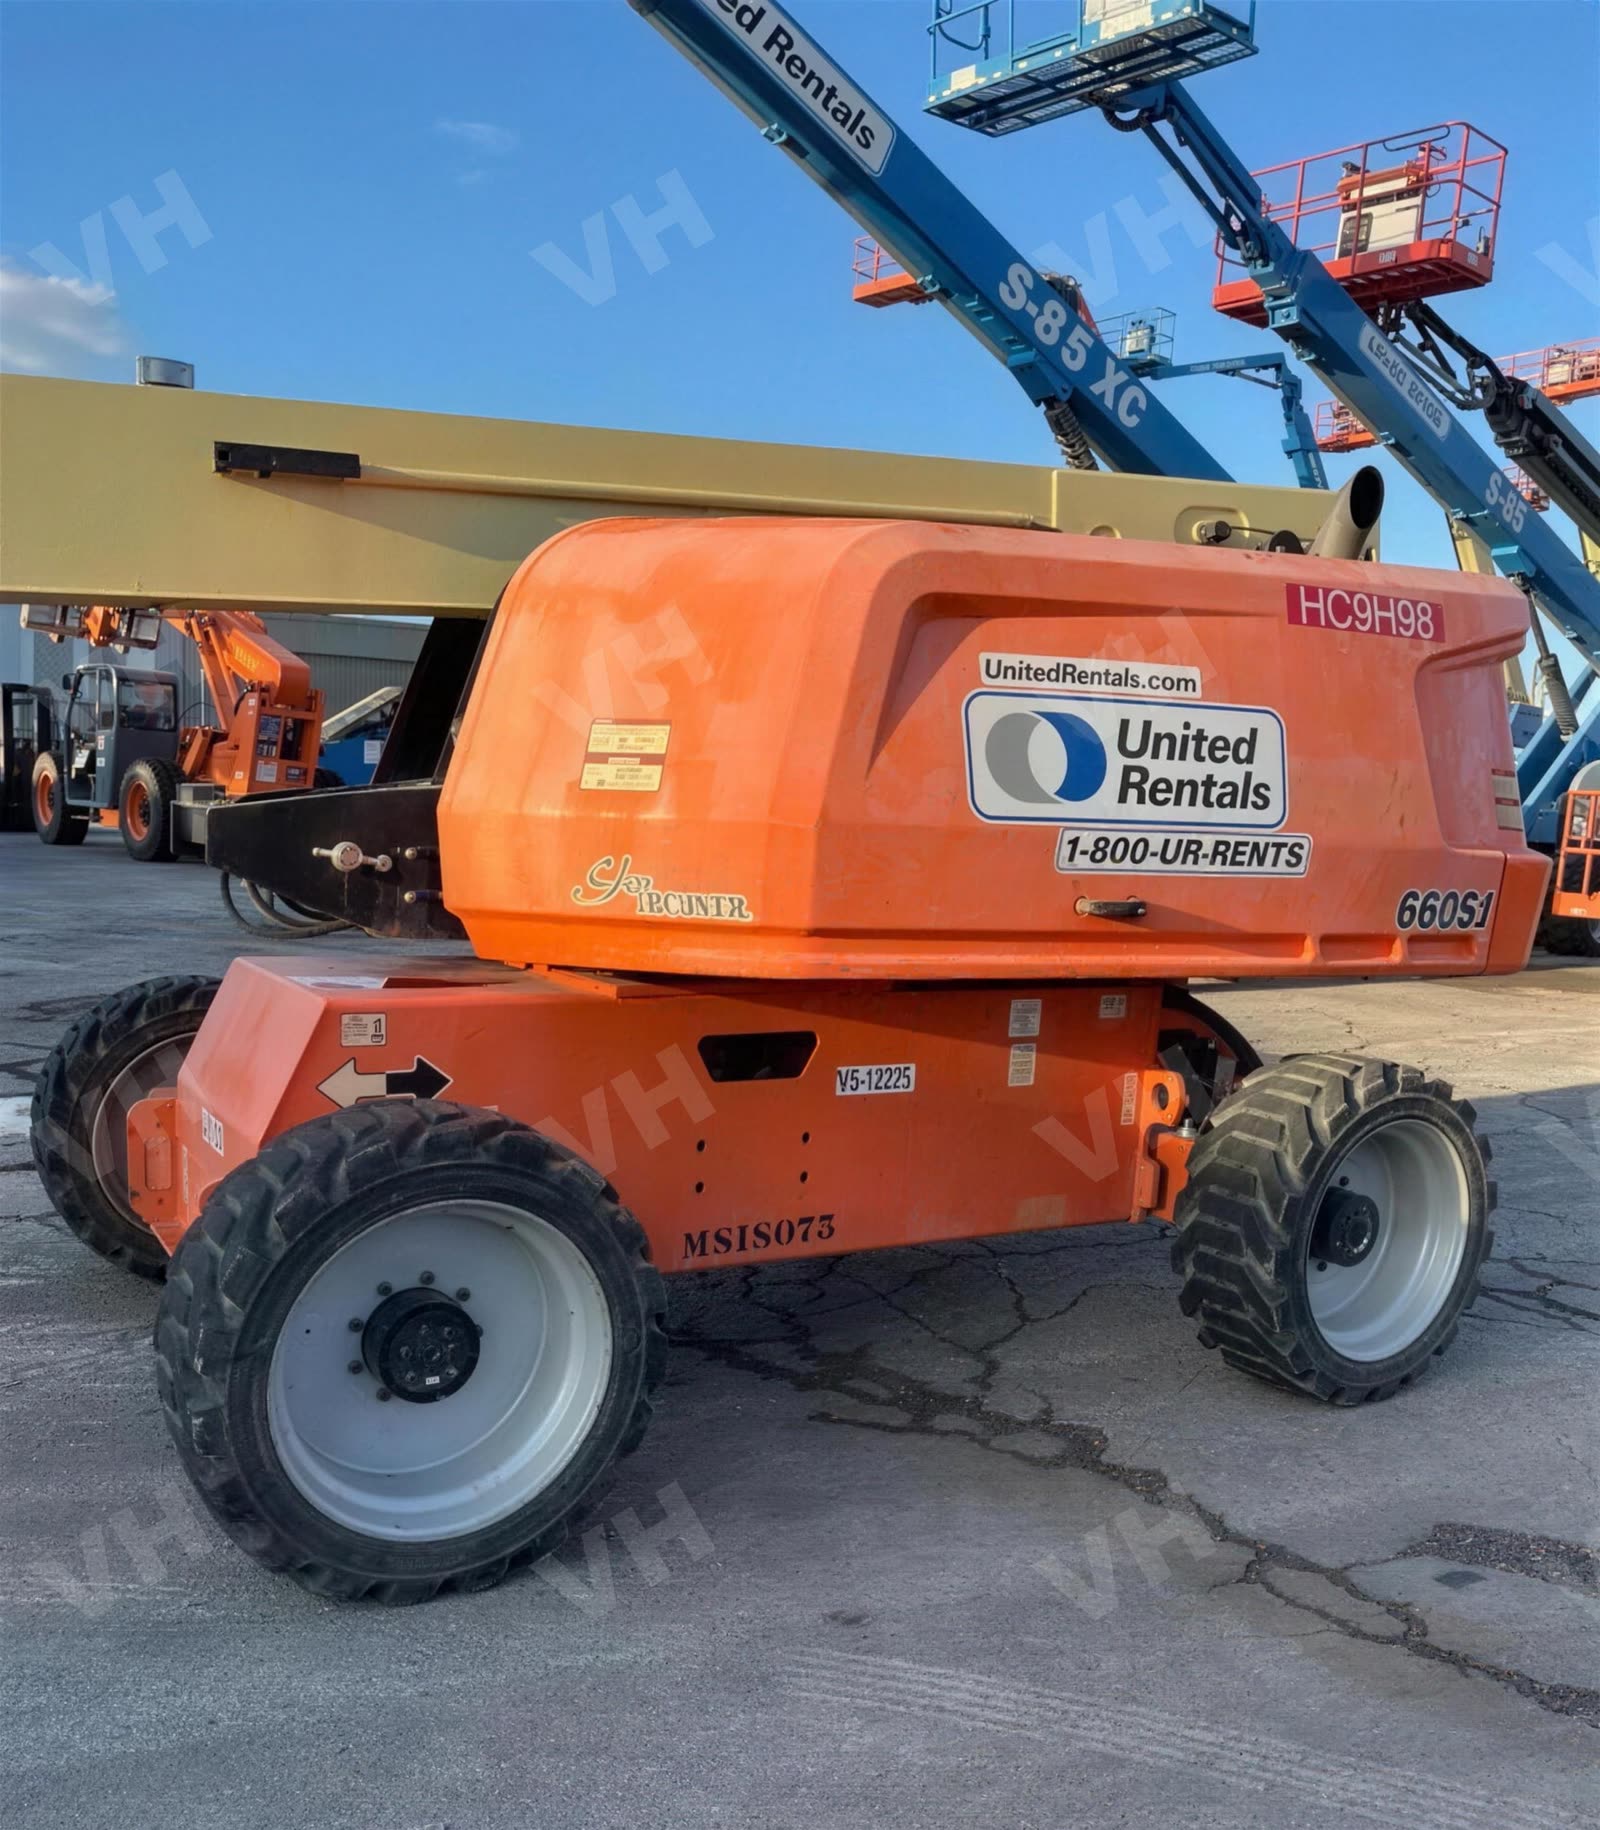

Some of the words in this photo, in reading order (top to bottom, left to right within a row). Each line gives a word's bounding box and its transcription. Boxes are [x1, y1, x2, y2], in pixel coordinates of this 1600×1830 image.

[762, 24, 875, 150] Rentals
[999, 262, 1094, 372] S-85
[1089, 356, 1147, 428] XC
[1485, 471, 1528, 533] S-85
[1299, 585, 1434, 640] HC9H98
[984, 658, 1197, 693] UnitedRentals.com
[1117, 718, 1258, 765] United
[1117, 765, 1271, 811] Rentals
[1065, 836, 1304, 869] 1-800-UR-RENTS
[837, 1066, 911, 1092] V5-12225
